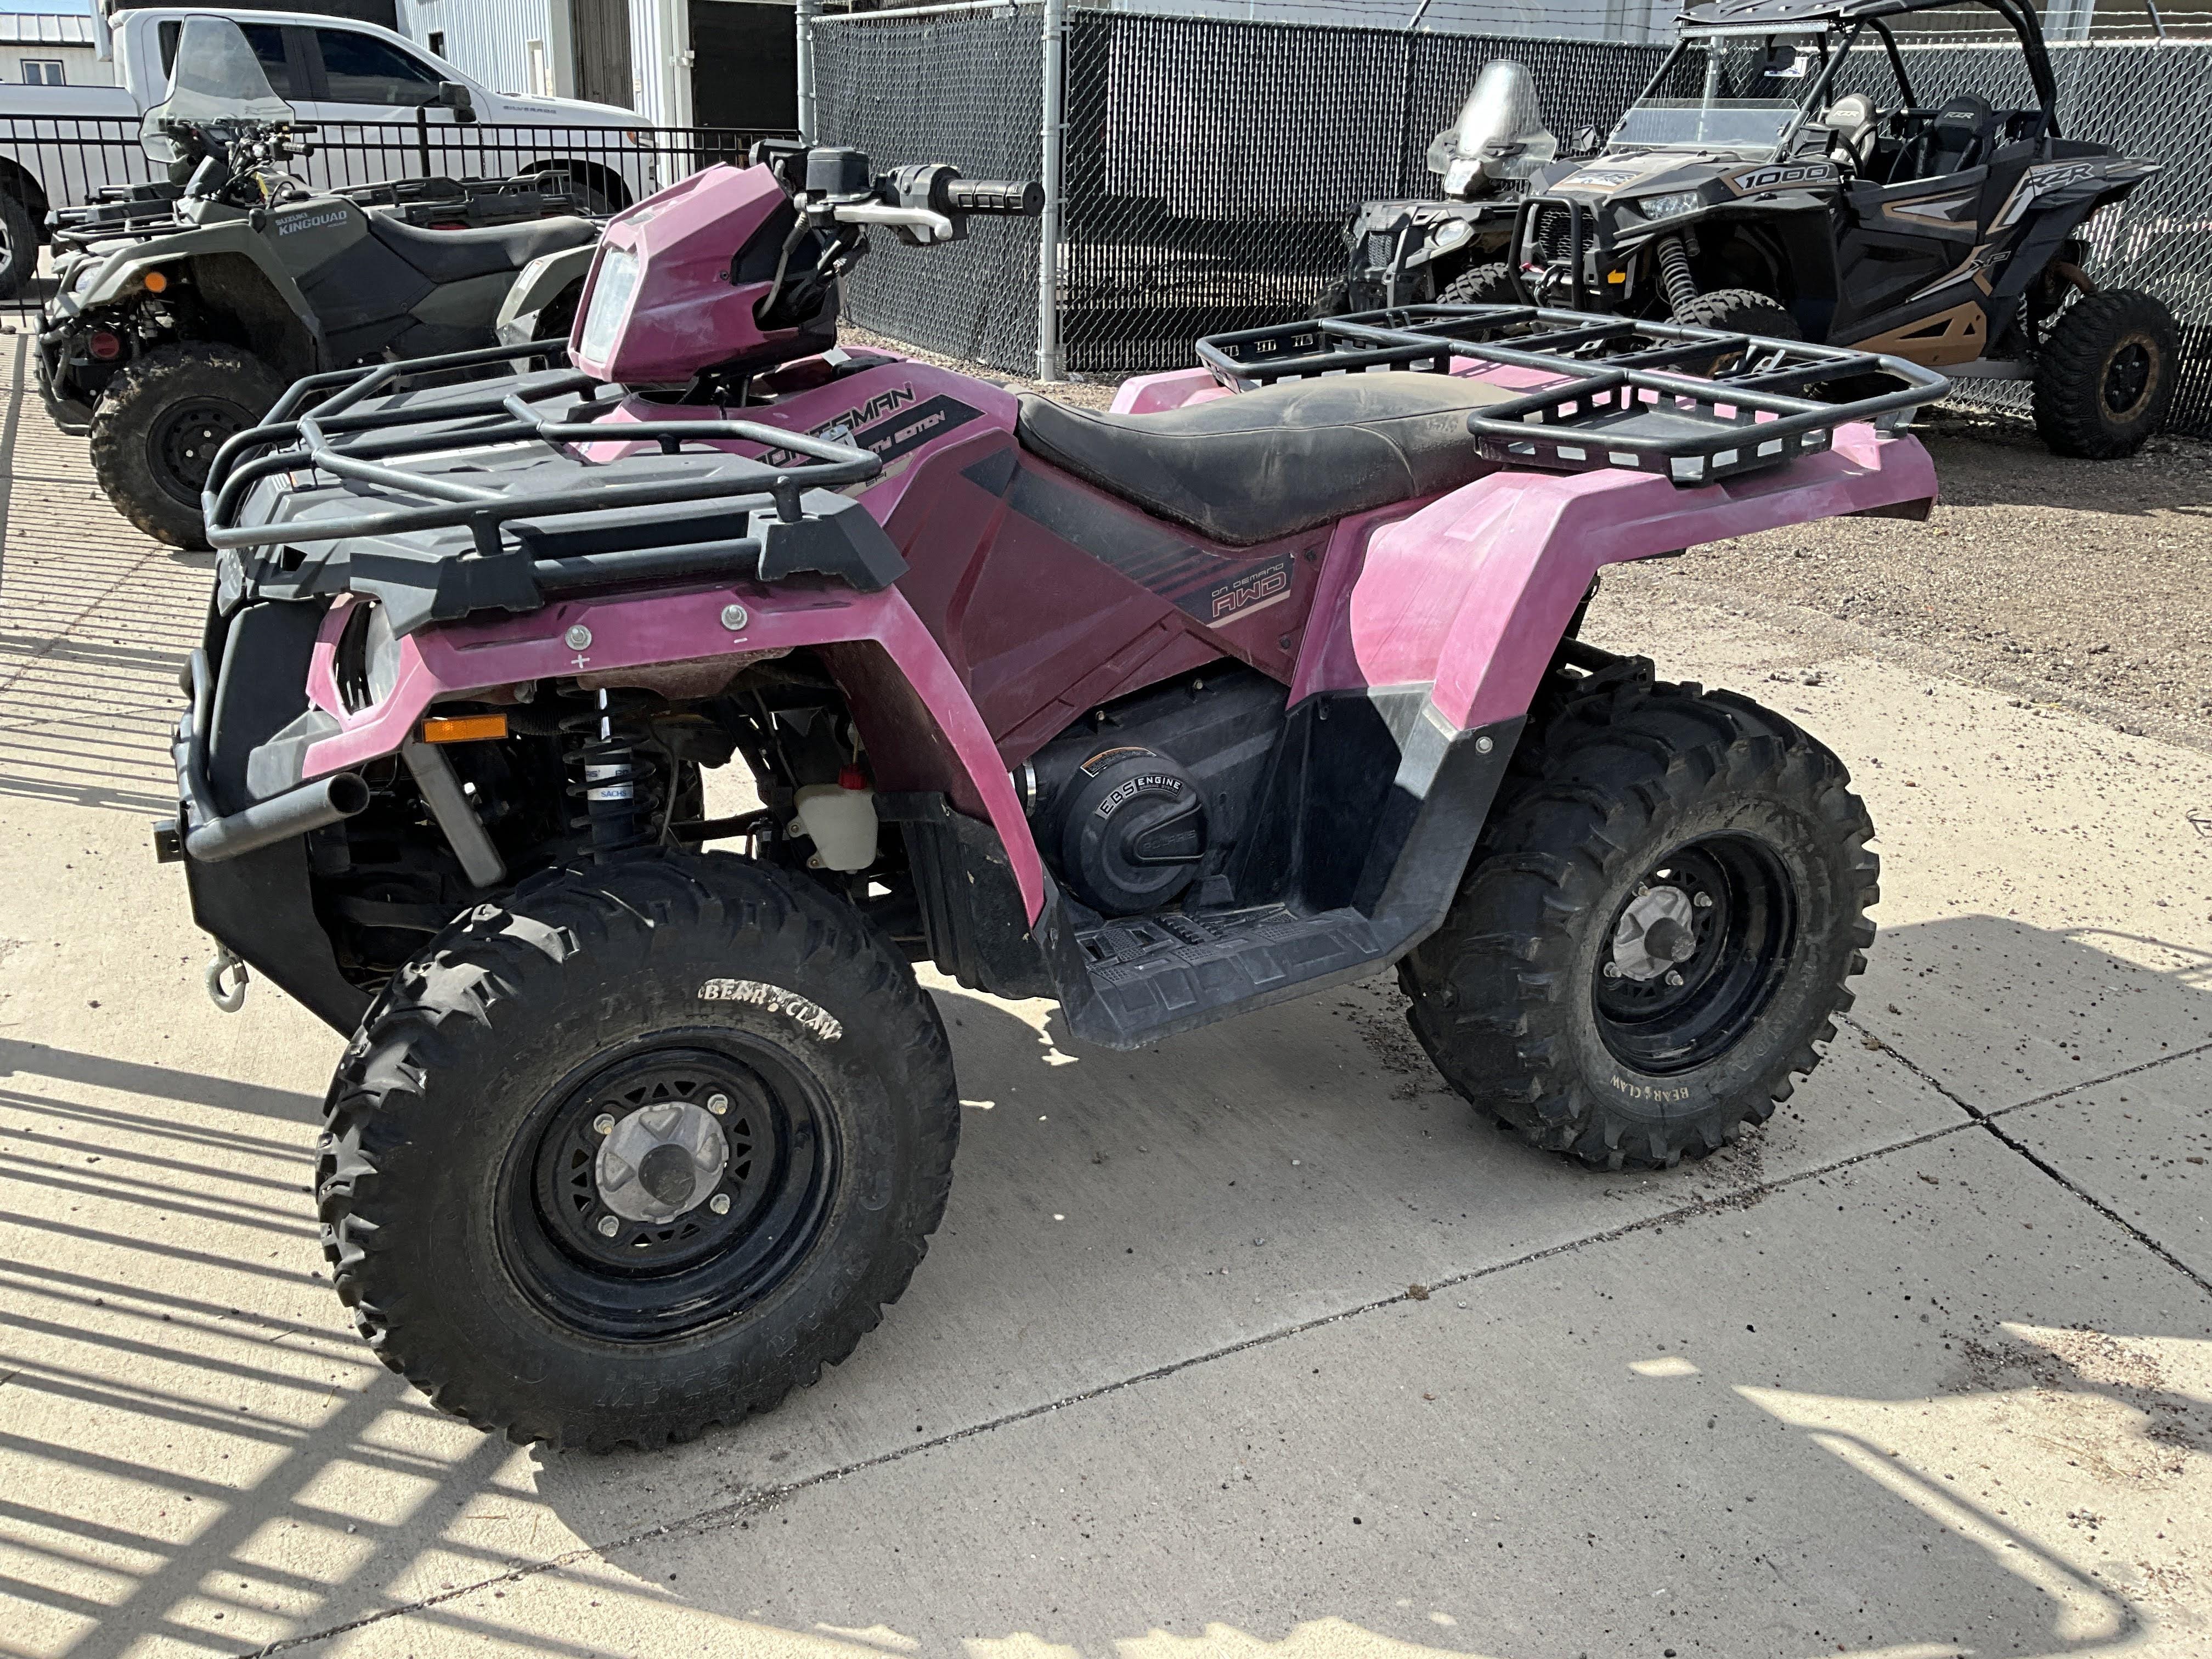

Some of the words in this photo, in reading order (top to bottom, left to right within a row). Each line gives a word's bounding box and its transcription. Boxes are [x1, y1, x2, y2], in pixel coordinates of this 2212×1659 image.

[1743, 165, 1830, 190] 1000
[2016, 163, 2095, 200] RZR
[275, 212, 307, 225] SUZUKI
[279, 210, 347, 236] KINGQUAD
[1233, 563, 1284, 588] DEMAND
[1212, 572, 1286, 618] AWD
[1099, 781, 1135, 815] EBS
[1137, 776, 1181, 789] ENGINE
[704, 982, 768, 1005] BEAR
[786, 1002, 842, 1041] CLAW
[1610, 1074, 1641, 1098] CLAW
[1654, 1087, 1689, 1102] BEAR
